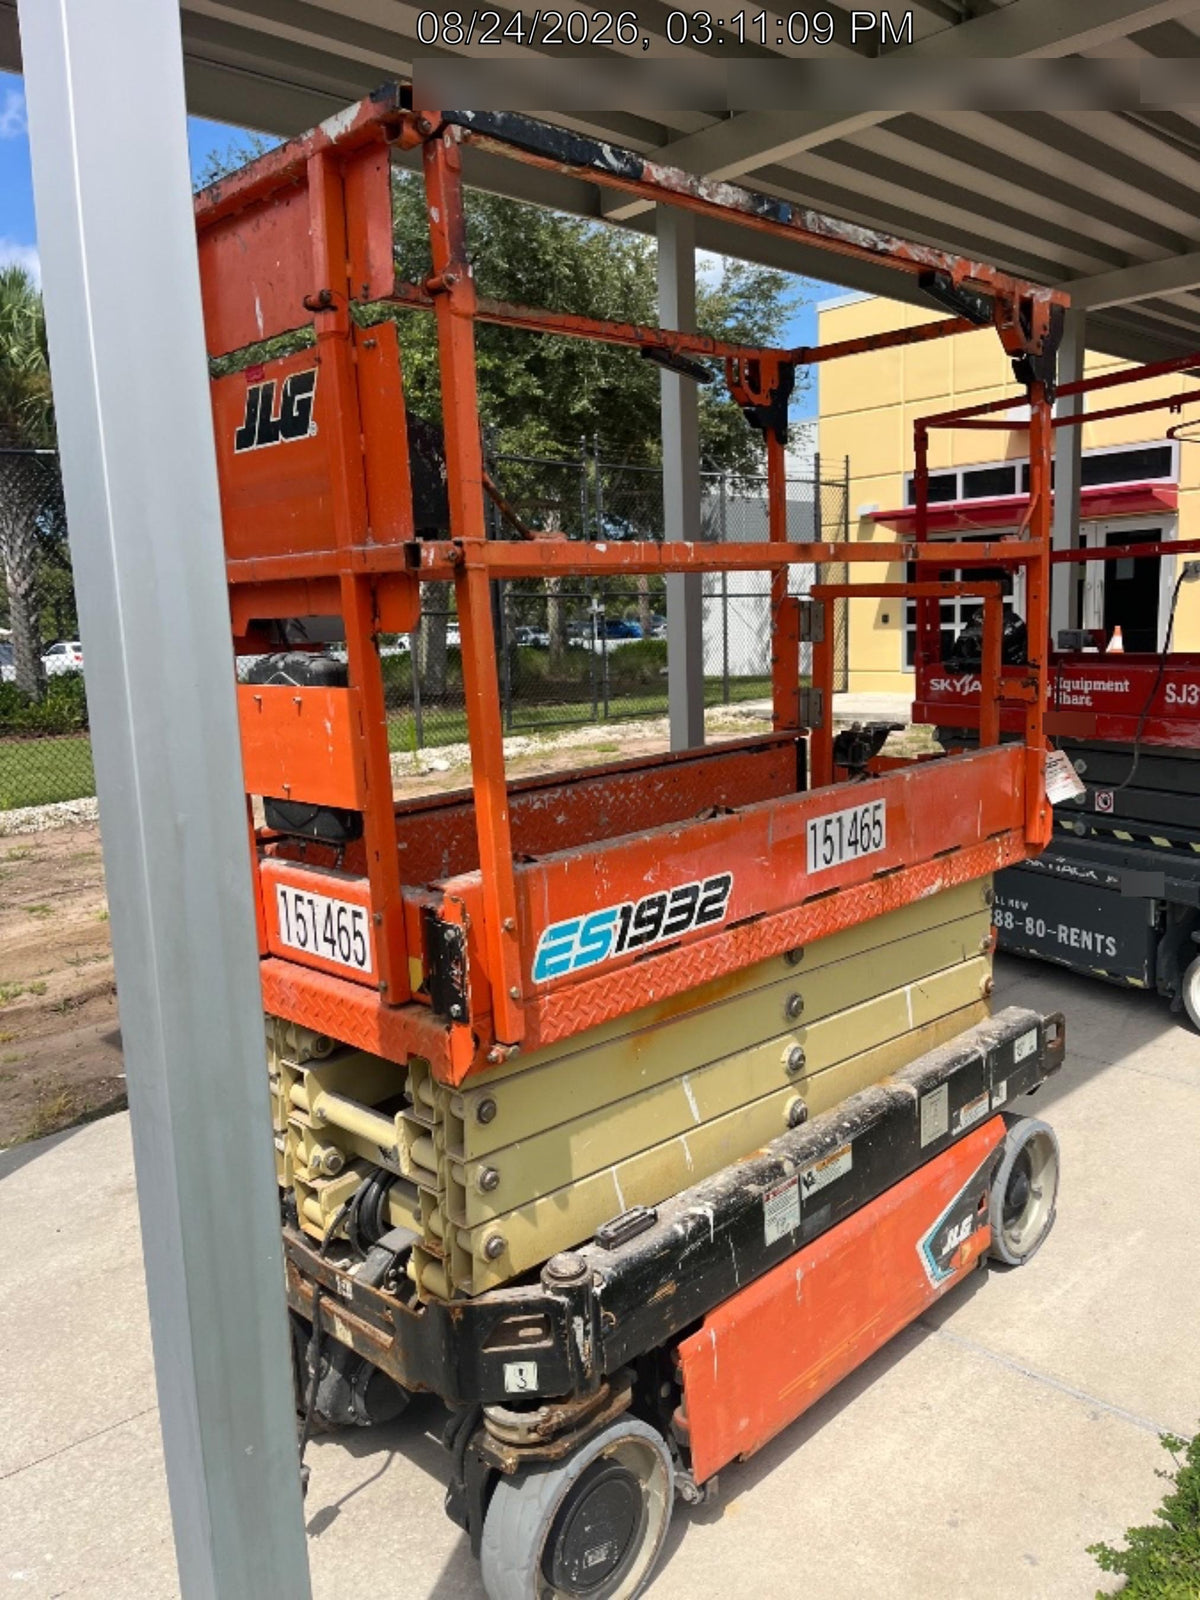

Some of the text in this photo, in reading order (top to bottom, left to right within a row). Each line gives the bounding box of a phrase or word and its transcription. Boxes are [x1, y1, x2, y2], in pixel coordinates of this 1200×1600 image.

[234, 367, 318, 454] JLG
[929, 674, 982, 696] SKYJA
[1164, 682, 1200, 705] SJ3
[809, 803, 884, 869] 151465
[280, 890, 366, 967] 151465
[533, 873, 733, 983] ES1932
[994, 908, 1117, 957] 88-80-RENTS
